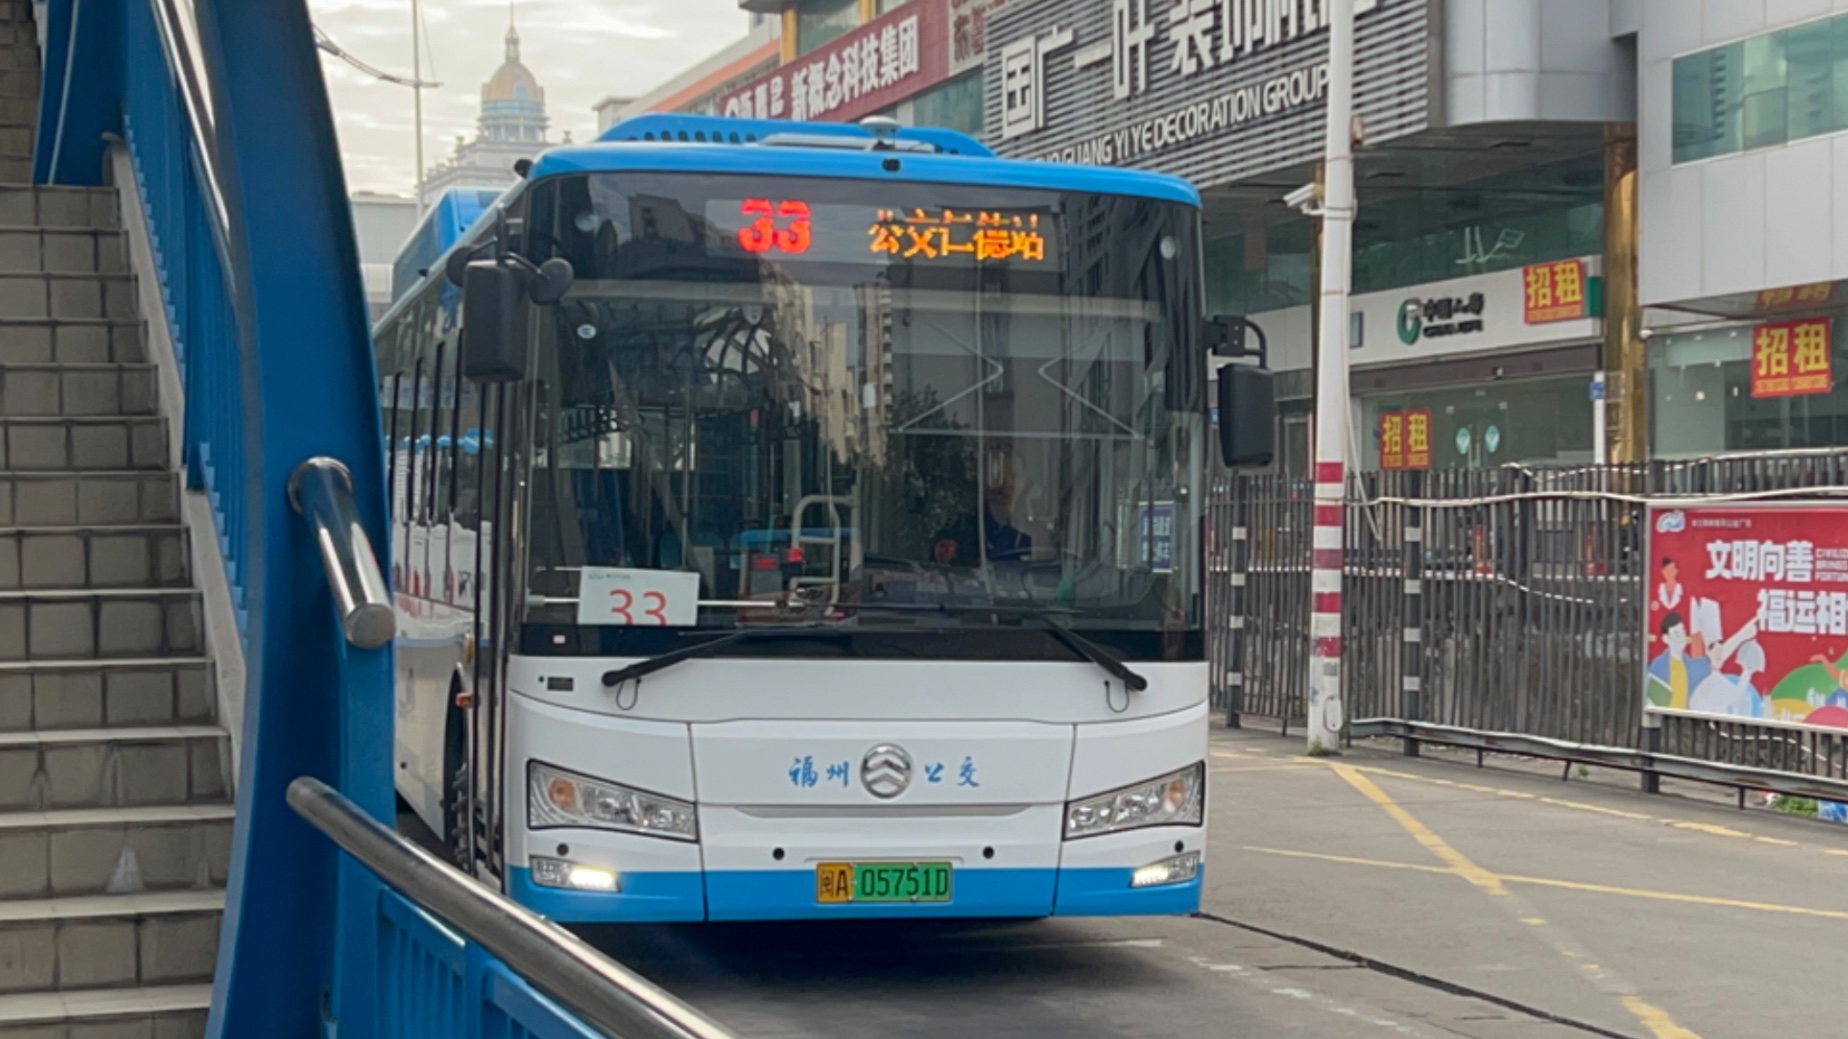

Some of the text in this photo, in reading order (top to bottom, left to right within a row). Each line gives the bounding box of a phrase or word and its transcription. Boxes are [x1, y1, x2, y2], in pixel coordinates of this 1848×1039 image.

[791, 19, 920, 121] 新概念科技集团
[1114, 129, 1129, 159] YI
[1154, 86, 1260, 148] DECORATION
[1263, 64, 1330, 113] GROUP
[739, 198, 812, 253] 33
[1526, 262, 1582, 308] 招租
[1756, 324, 1829, 376] 招租
[1383, 414, 1428, 454] 招租
[1705, 539, 1814, 582] 文明向善
[1757, 588, 1848, 635] 福运相
[789, 755, 980, 788] 福州 公交
